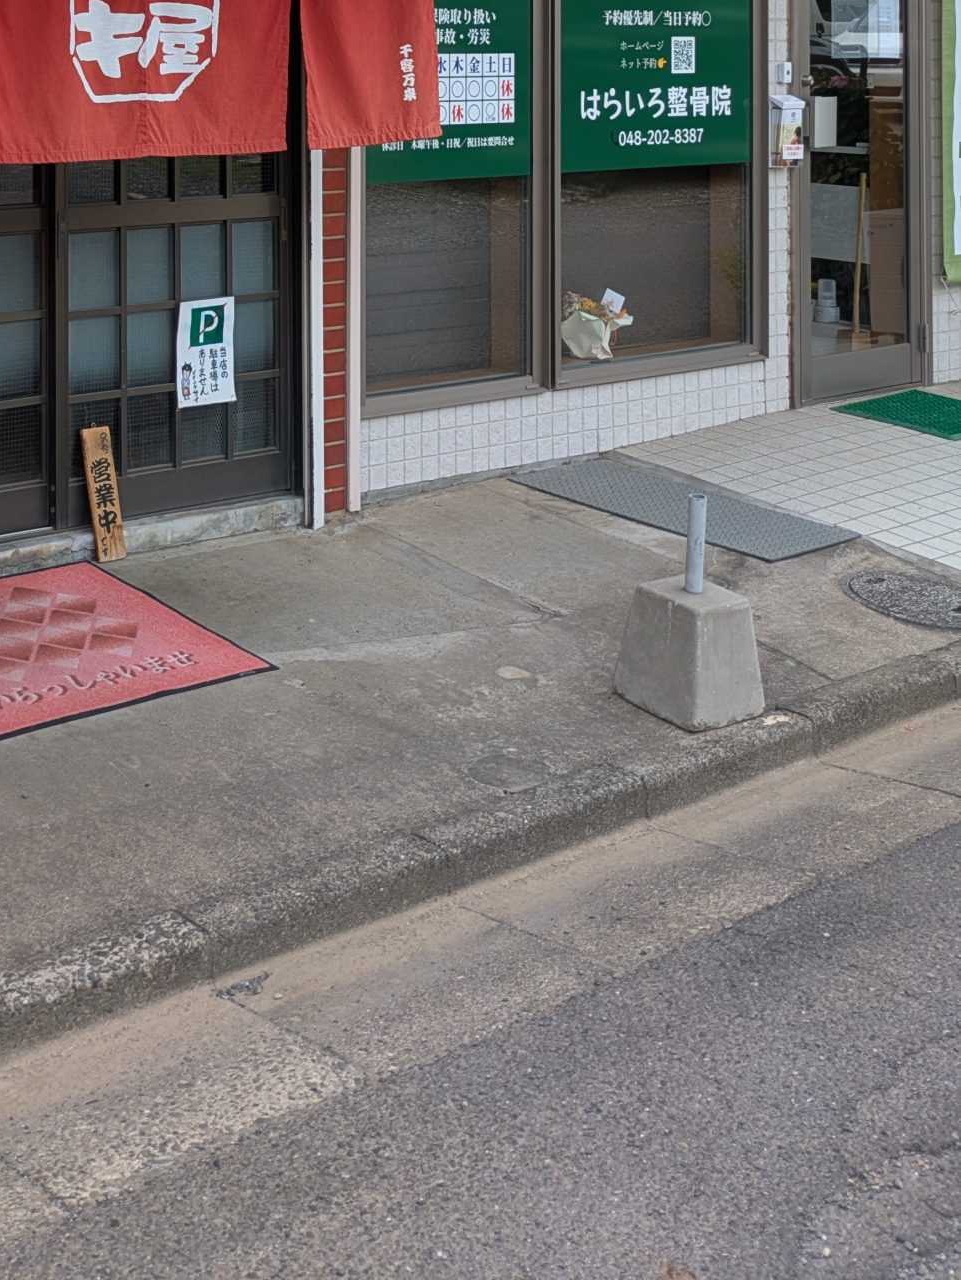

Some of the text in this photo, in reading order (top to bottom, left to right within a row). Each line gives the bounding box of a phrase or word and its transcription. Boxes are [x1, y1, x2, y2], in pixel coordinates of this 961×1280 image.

[619, 40, 665, 51] ホームページ
[451, 56, 464, 74] 木
[469, 56, 481, 74] 金
[485, 56, 497, 74] 土
[502, 56, 512, 74] 日
[619, 57, 657, 69] ネット予約
[501, 79, 513, 97] 休
[580, 84, 732, 120] はらいろ整骨院
[452, 103, 513, 122] 休 休
[618, 128, 704, 147] 048-202-8387
[198, 309, 219, 344] P
[208, 348, 220, 393] 駐車場は
[219, 345, 229, 379] 当店の
[198, 348, 209, 397] ありません
